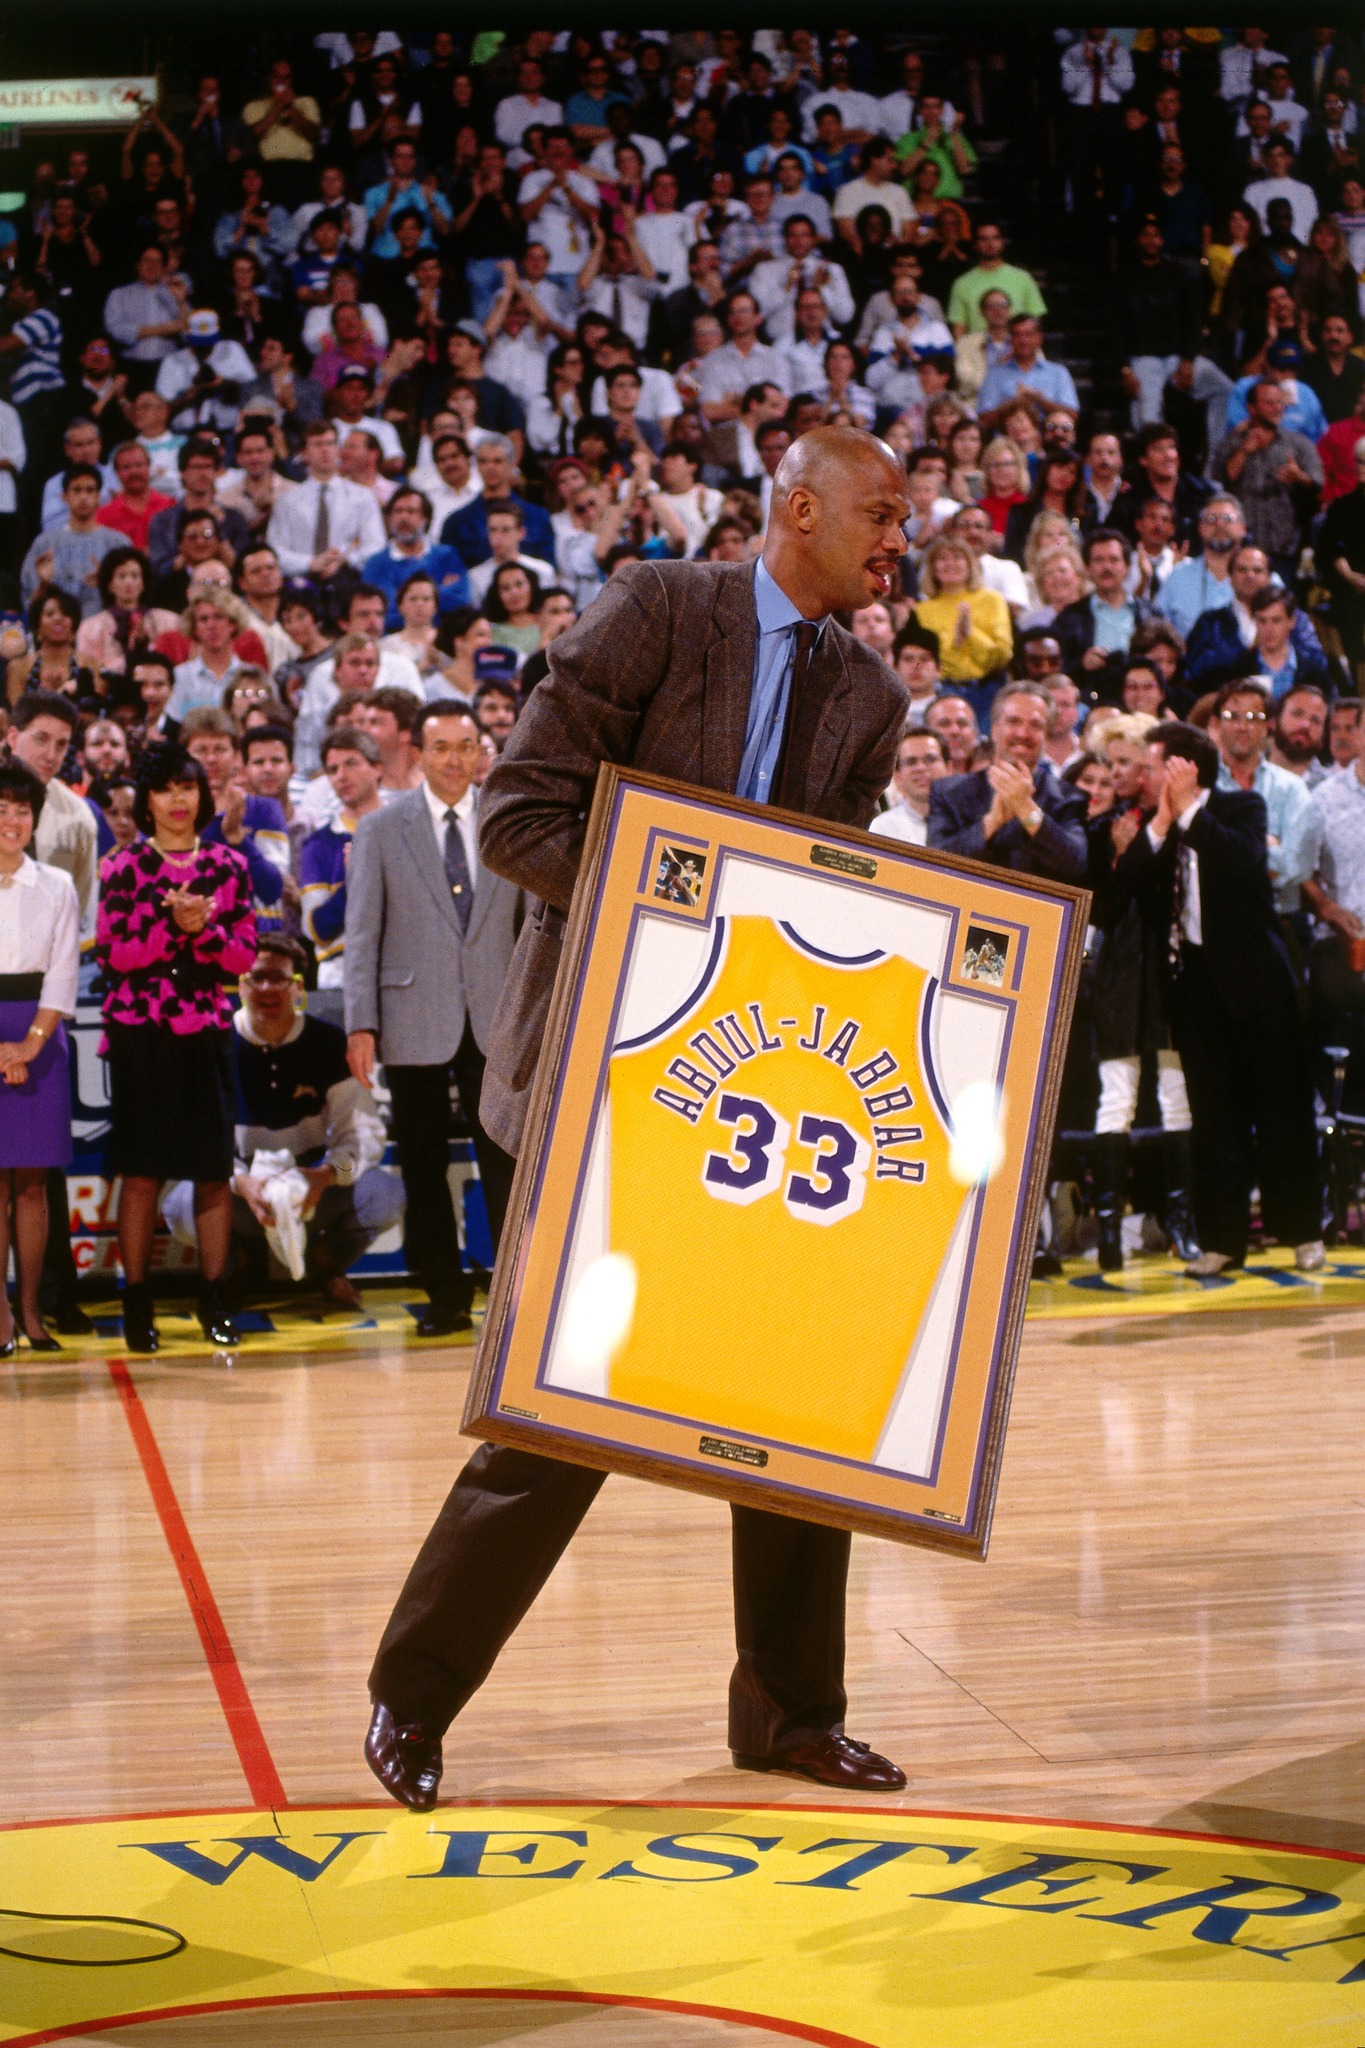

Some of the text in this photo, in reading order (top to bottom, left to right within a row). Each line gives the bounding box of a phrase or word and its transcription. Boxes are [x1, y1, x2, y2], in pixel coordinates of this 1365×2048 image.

[0, 89, 99, 107] AIRLINES
[652, 1003, 926, 1184] ABDUL-JABBAR
[703, 1092, 871, 1226] 33
